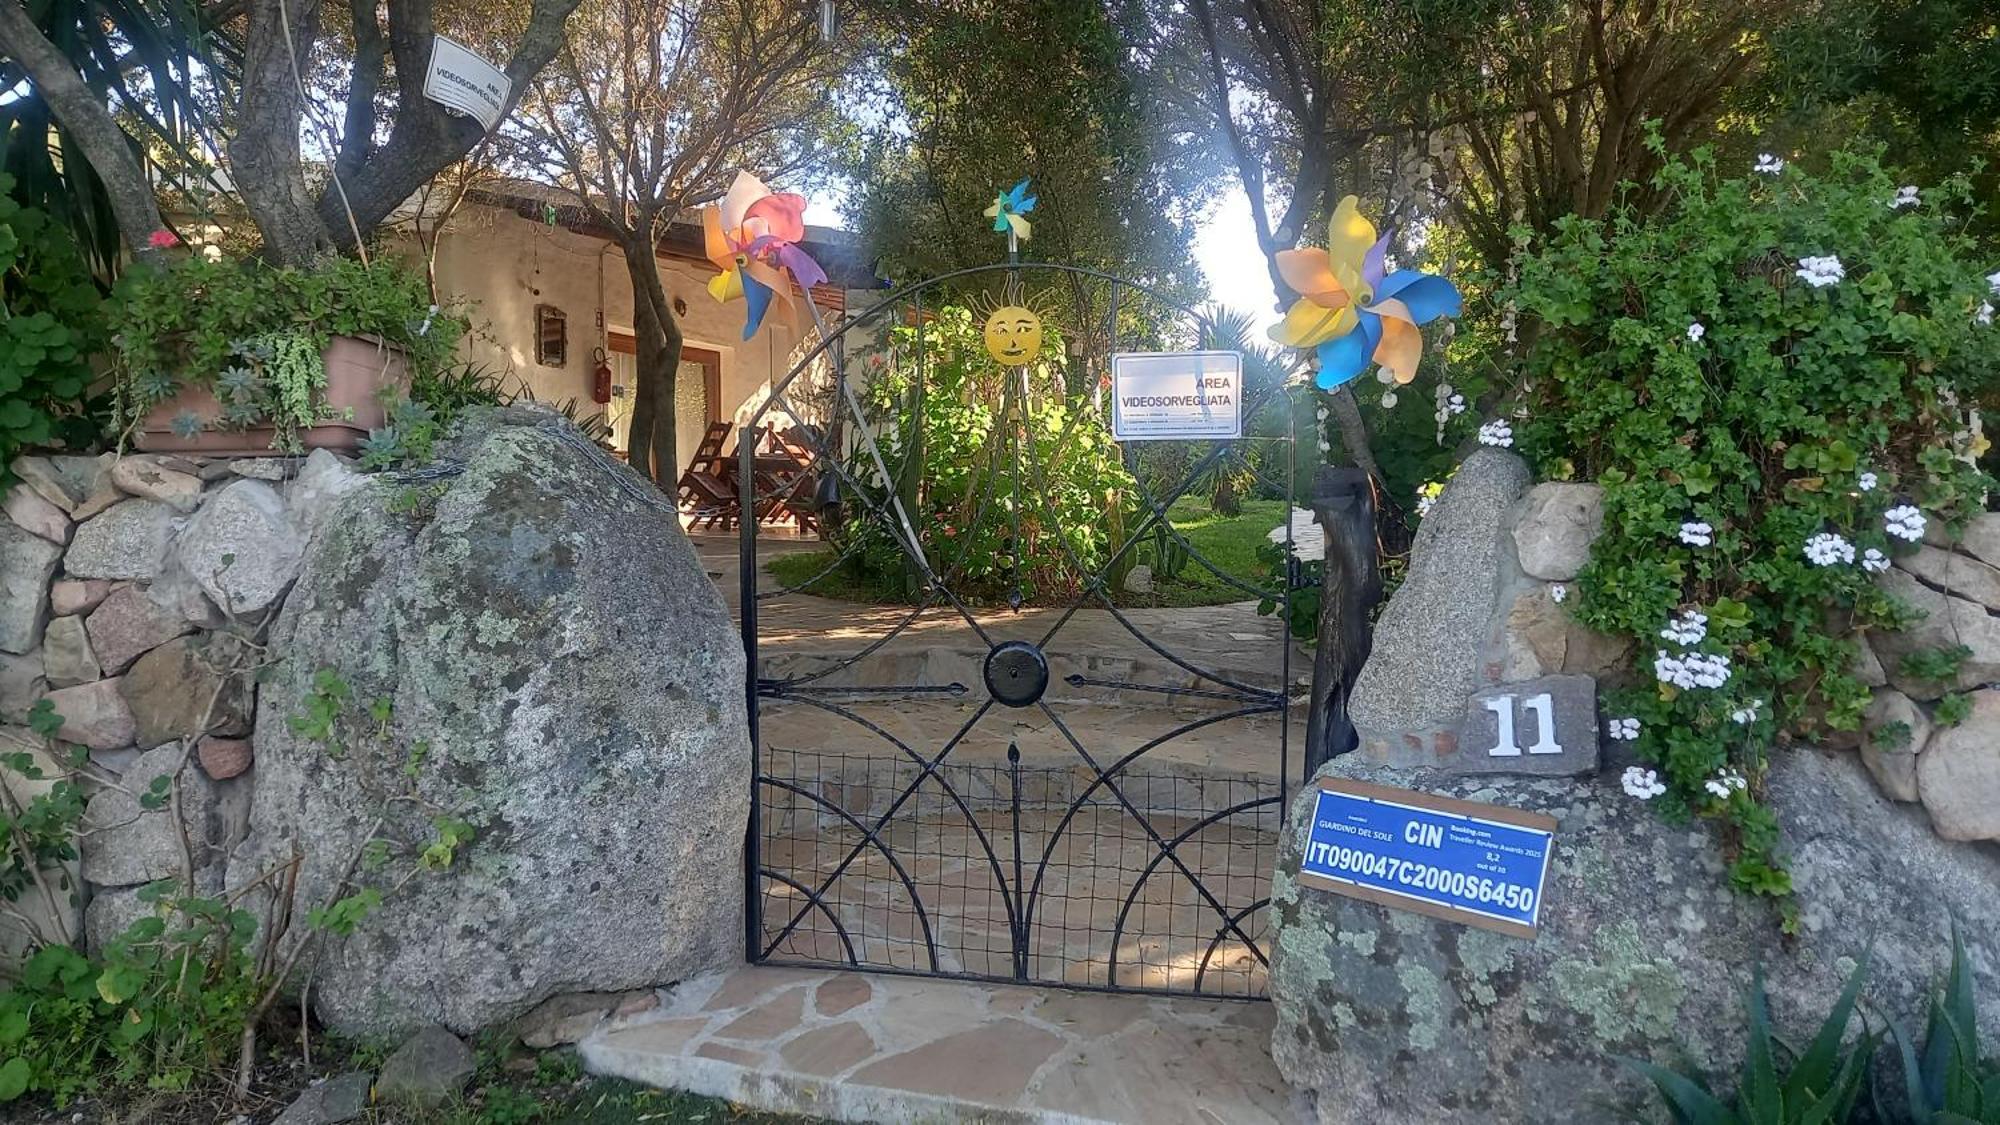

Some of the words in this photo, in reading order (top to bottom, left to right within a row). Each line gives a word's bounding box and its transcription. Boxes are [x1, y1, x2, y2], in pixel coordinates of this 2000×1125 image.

[1196, 377, 1230, 389] AREA
[1122, 395, 1232, 408] VIDEOSORVEGLIATA
[1487, 693, 1563, 757] 11
[1319, 820, 1357, 834] GIARDINO
[1358, 828, 1373, 838] DEL
[1372, 831, 1393, 842] SOLE
[1404, 820, 1443, 849] CIN
[1308, 841, 1534, 912] IT090047C2000S6450
